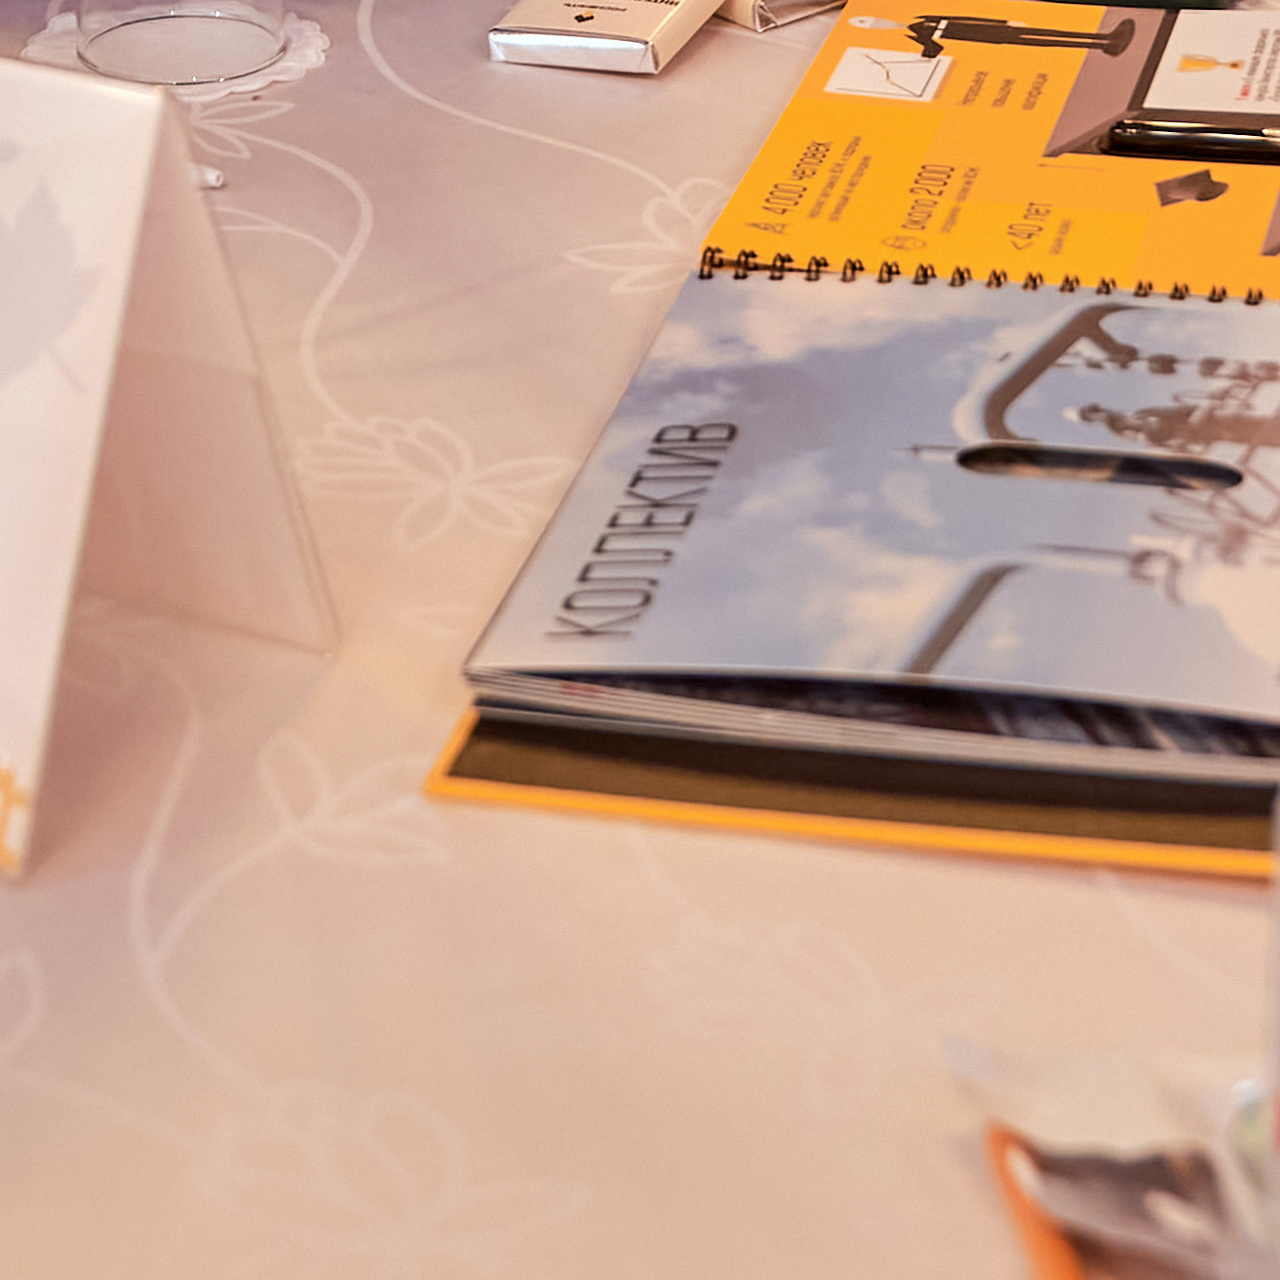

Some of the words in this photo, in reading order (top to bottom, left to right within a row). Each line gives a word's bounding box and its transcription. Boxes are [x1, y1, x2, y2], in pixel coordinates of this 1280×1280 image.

[761, 183, 807, 215] 4000
[788, 140, 833, 182] человек
[909, 163, 955, 197] 2000
[901, 198, 938, 230] около
[1023, 201, 1053, 222] лет
[545, 421, 739, 639] КОЛЛЕКТИВ
